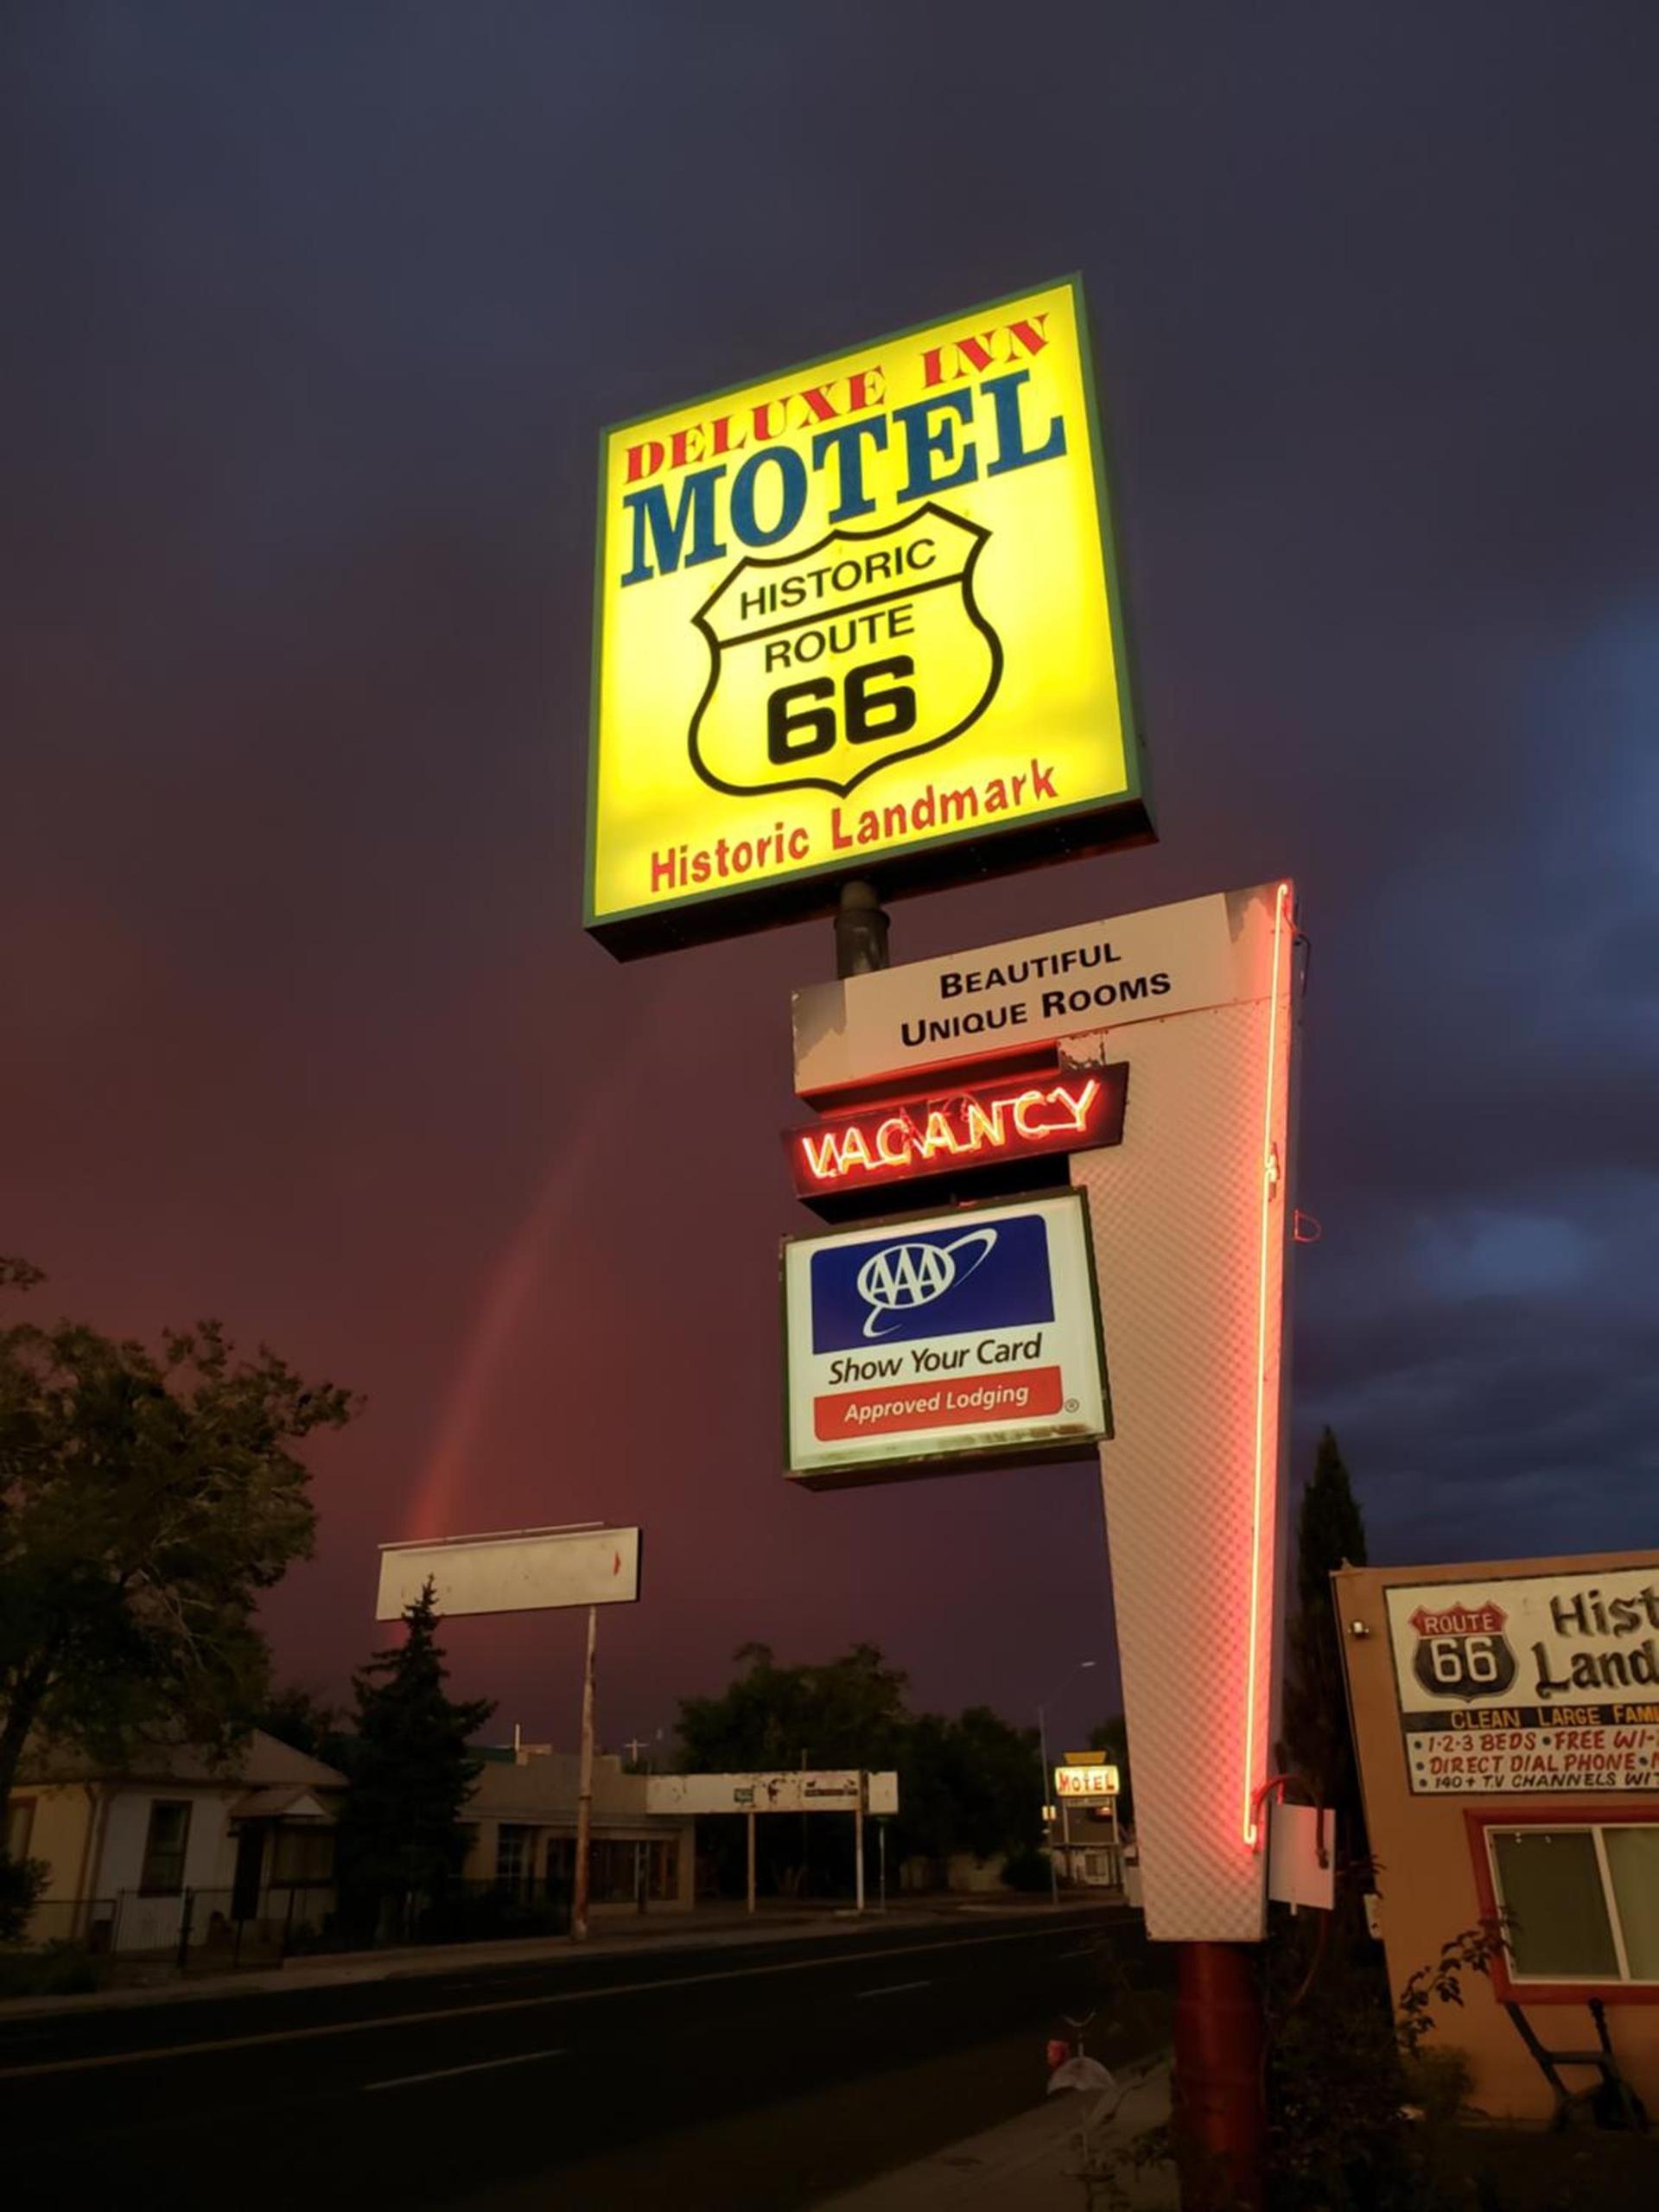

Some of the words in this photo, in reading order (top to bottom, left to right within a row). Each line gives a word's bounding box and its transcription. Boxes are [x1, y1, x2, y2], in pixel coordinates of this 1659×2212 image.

[626, 366, 885, 484] DELUXE
[923, 313, 1050, 389] INN
[620, 369, 1068, 588] MOTEL
[739, 537, 937, 620] HISTORIC
[765, 603, 915, 672] ROUTE
[767, 654, 917, 766] 66
[650, 822, 810, 893] Historic
[831, 758, 1058, 851] Landmark
[802, 1079, 1099, 1179] VACANCY
[828, 1355, 902, 1386] Show
[911, 1348, 970, 1374] Your
[976, 1333, 1042, 1365] Card
[843, 1392, 940, 1425] Approved
[945, 1384, 1030, 1412] Lodging
[1423, 1612, 1495, 1636] ROUTE
[1430, 1636, 1498, 1683] 66
[1451, 1710, 1522, 1730] CLEAN
[1537, 1707, 1601, 1726] LARGE
[1480, 1732, 1537, 1752] BEDS
[1554, 1729, 1606, 1751] FREE
[1057, 1772, 1116, 1793] MOTEL
[1428, 1755, 1503, 1775] DIRECT
[1510, 1754, 1559, 1773] DIAL
[1564, 1752, 1636, 1772] PHONE
[1512, 1771, 1616, 1788] CHANNELS
